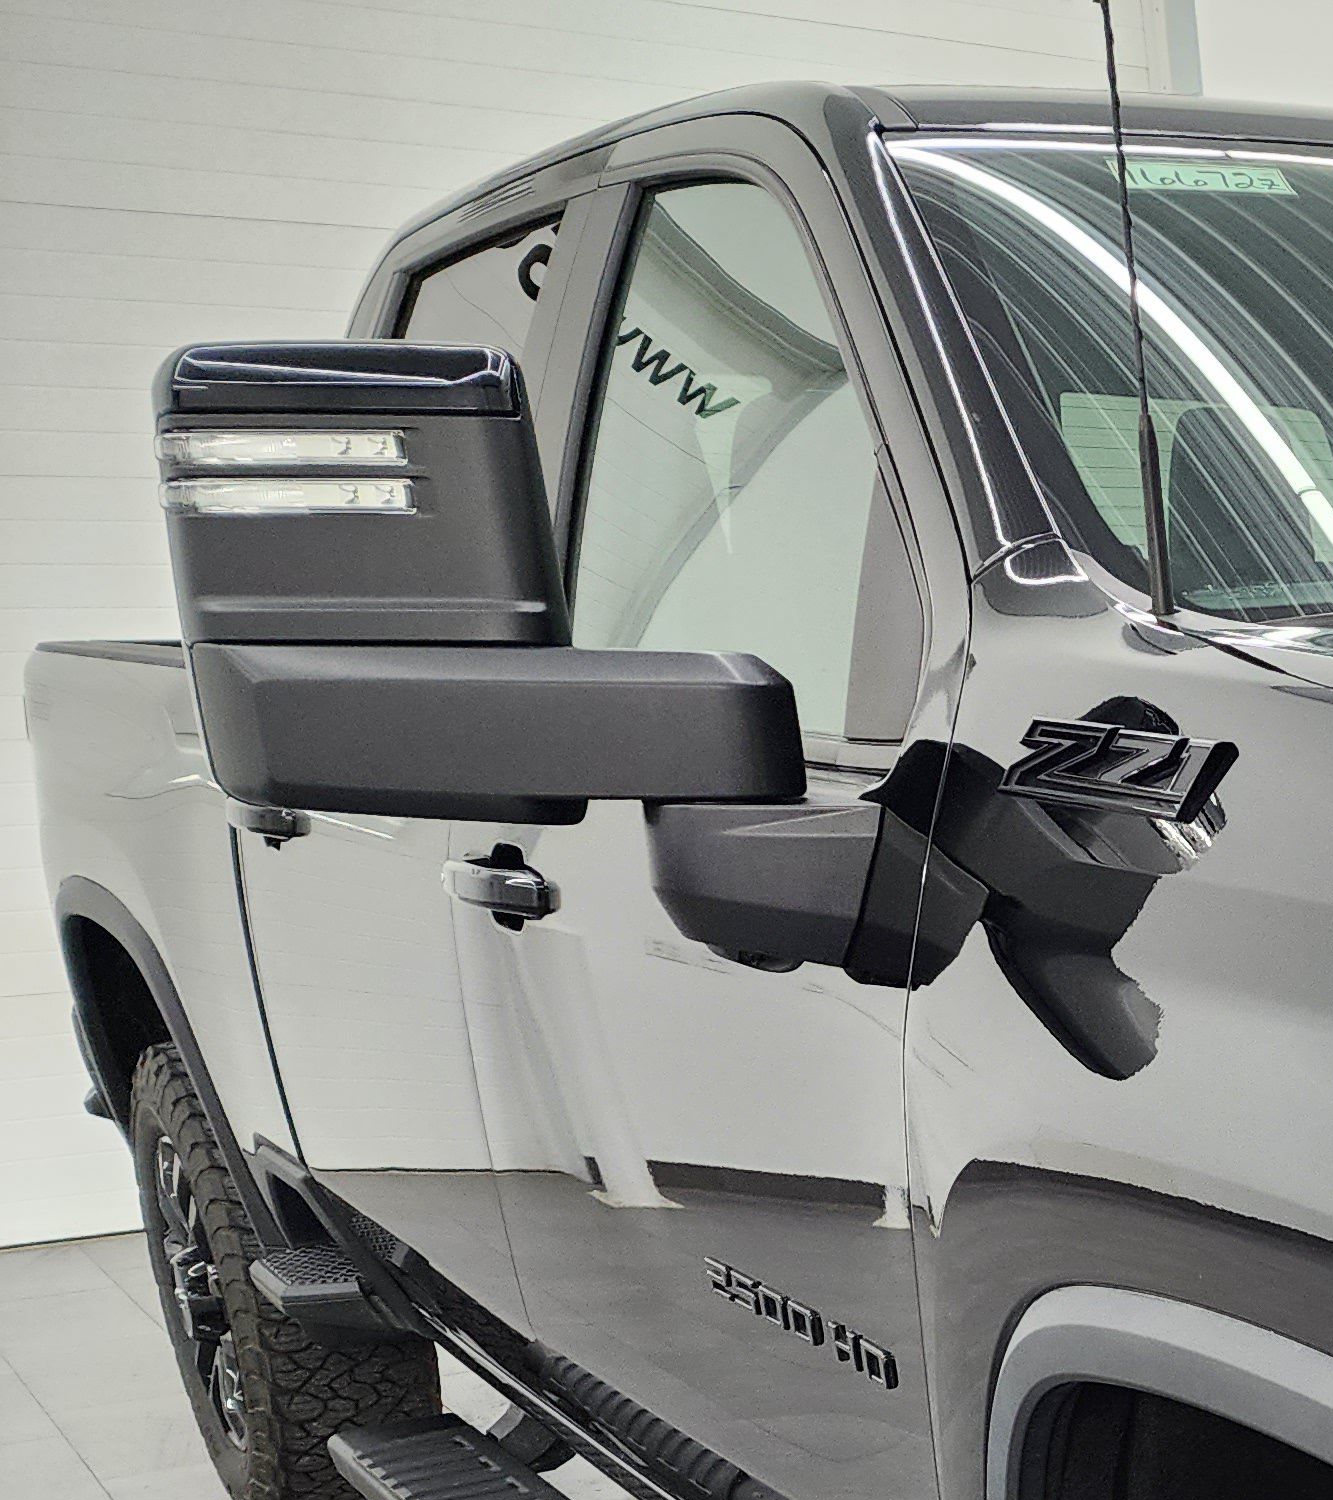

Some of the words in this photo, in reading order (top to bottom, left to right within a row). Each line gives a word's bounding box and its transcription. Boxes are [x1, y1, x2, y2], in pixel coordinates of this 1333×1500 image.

[998, 716, 1240, 824] Z71
[704, 1256, 825, 1346] 2500
[827, 1320, 899, 1390] HD
